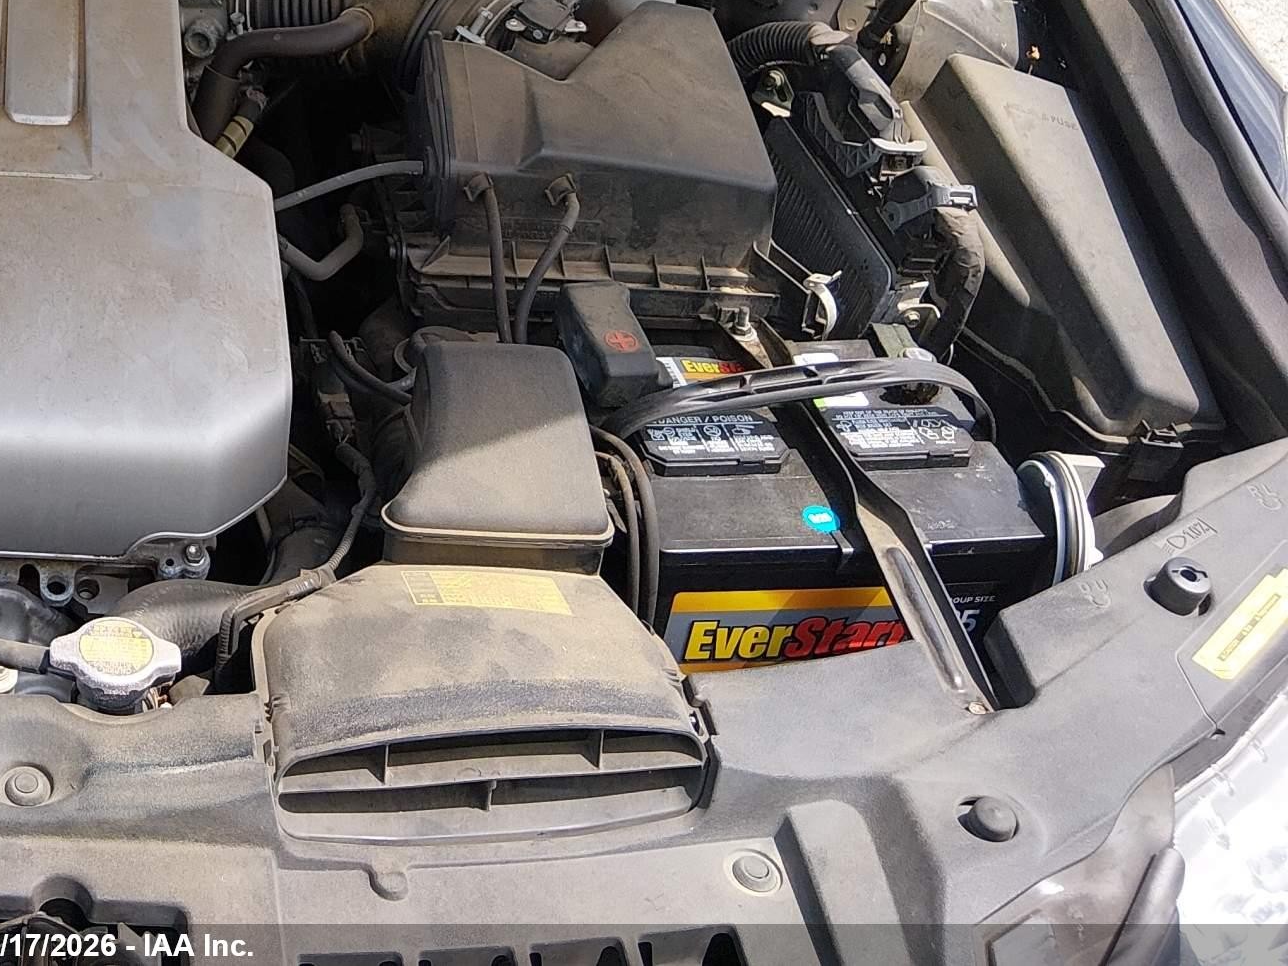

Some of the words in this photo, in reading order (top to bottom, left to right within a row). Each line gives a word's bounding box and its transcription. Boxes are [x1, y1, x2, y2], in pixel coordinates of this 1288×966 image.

[711, 414, 753, 424] POISON
[951, 596, 974, 604] OUP
[955, 609, 981, 632] 5
